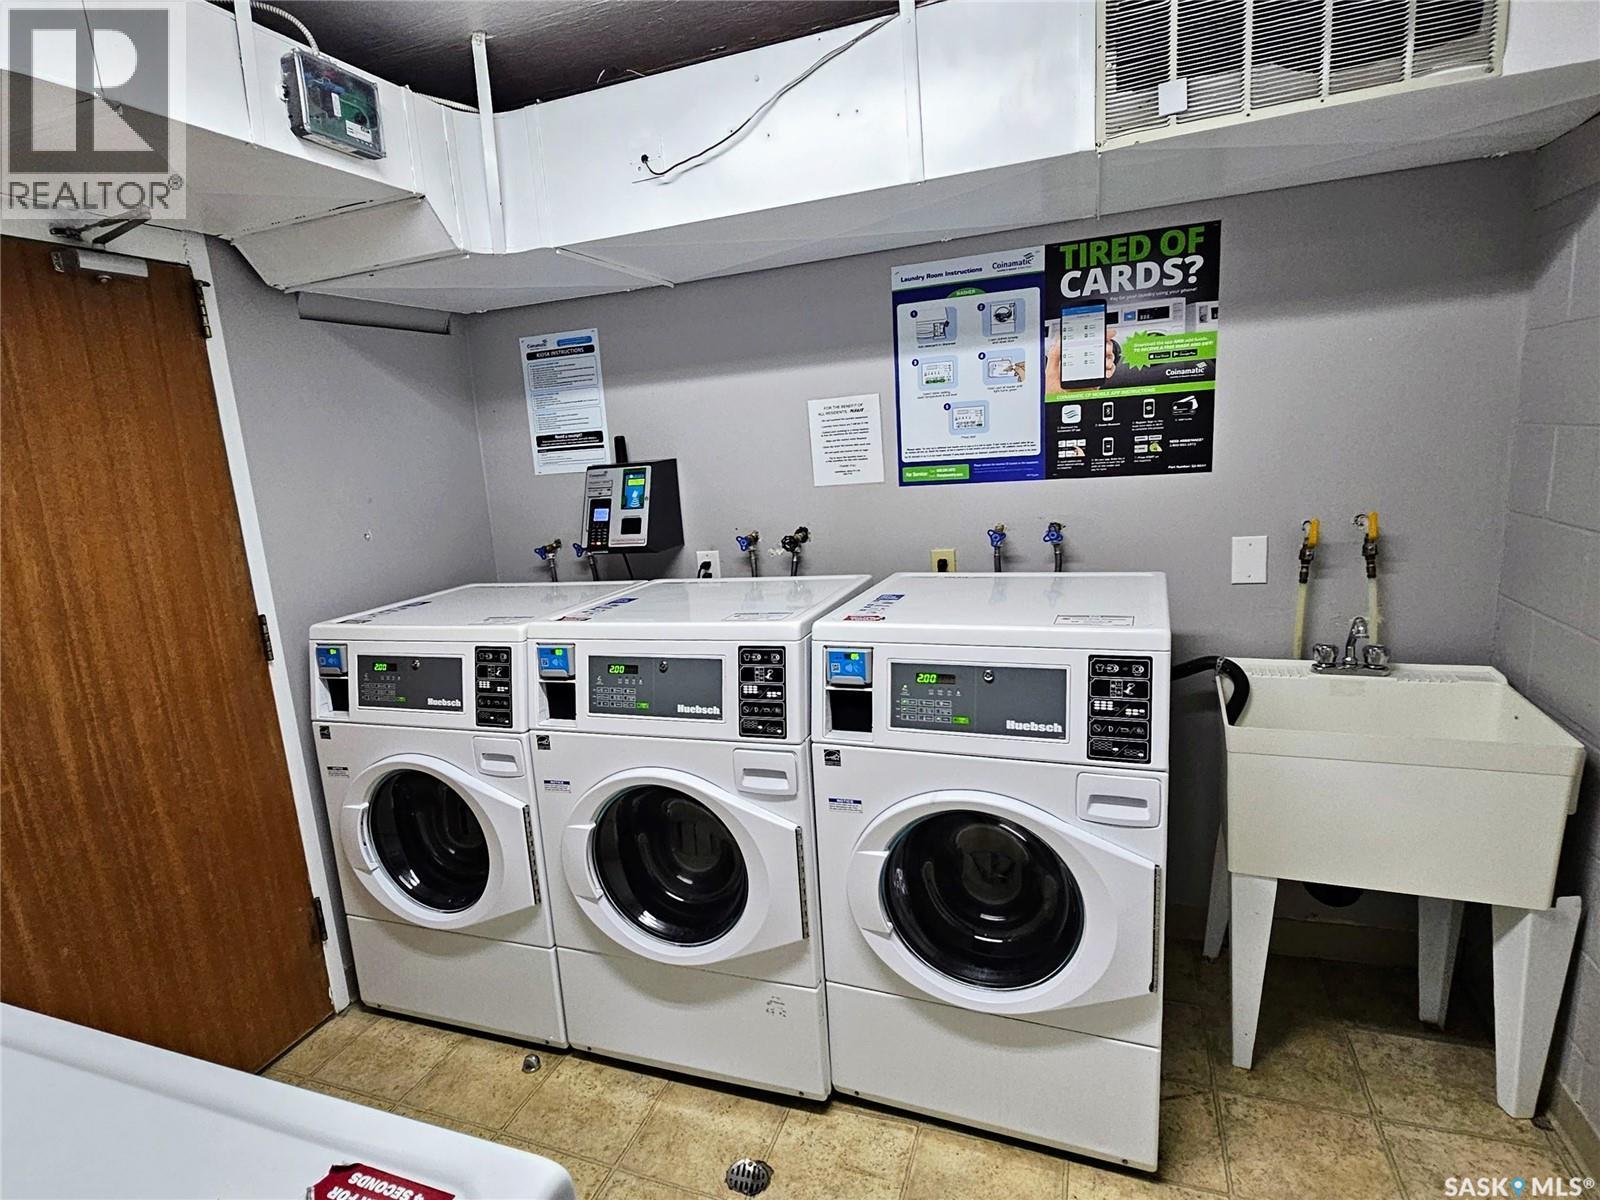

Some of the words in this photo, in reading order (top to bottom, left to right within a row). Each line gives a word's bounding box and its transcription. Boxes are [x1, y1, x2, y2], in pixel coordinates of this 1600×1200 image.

[1059, 234, 1151, 270] TIRED
[1160, 225, 1205, 256] OF
[992, 259, 1033, 270] Coinamatic
[900, 275, 925, 284] Laundry
[945, 266, 983, 277] Instructions
[1060, 254, 1205, 299] CARDS?
[551, 347, 585, 357] INSTRUCTIONS
[1165, 367, 1205, 376] Coinamatic
[427, 697, 461, 707] Huebsch
[677, 704, 721, 715] Huebsch
[1006, 719, 1063, 734] Huebsch
[348, 1172, 414, 1200] SECONDS
